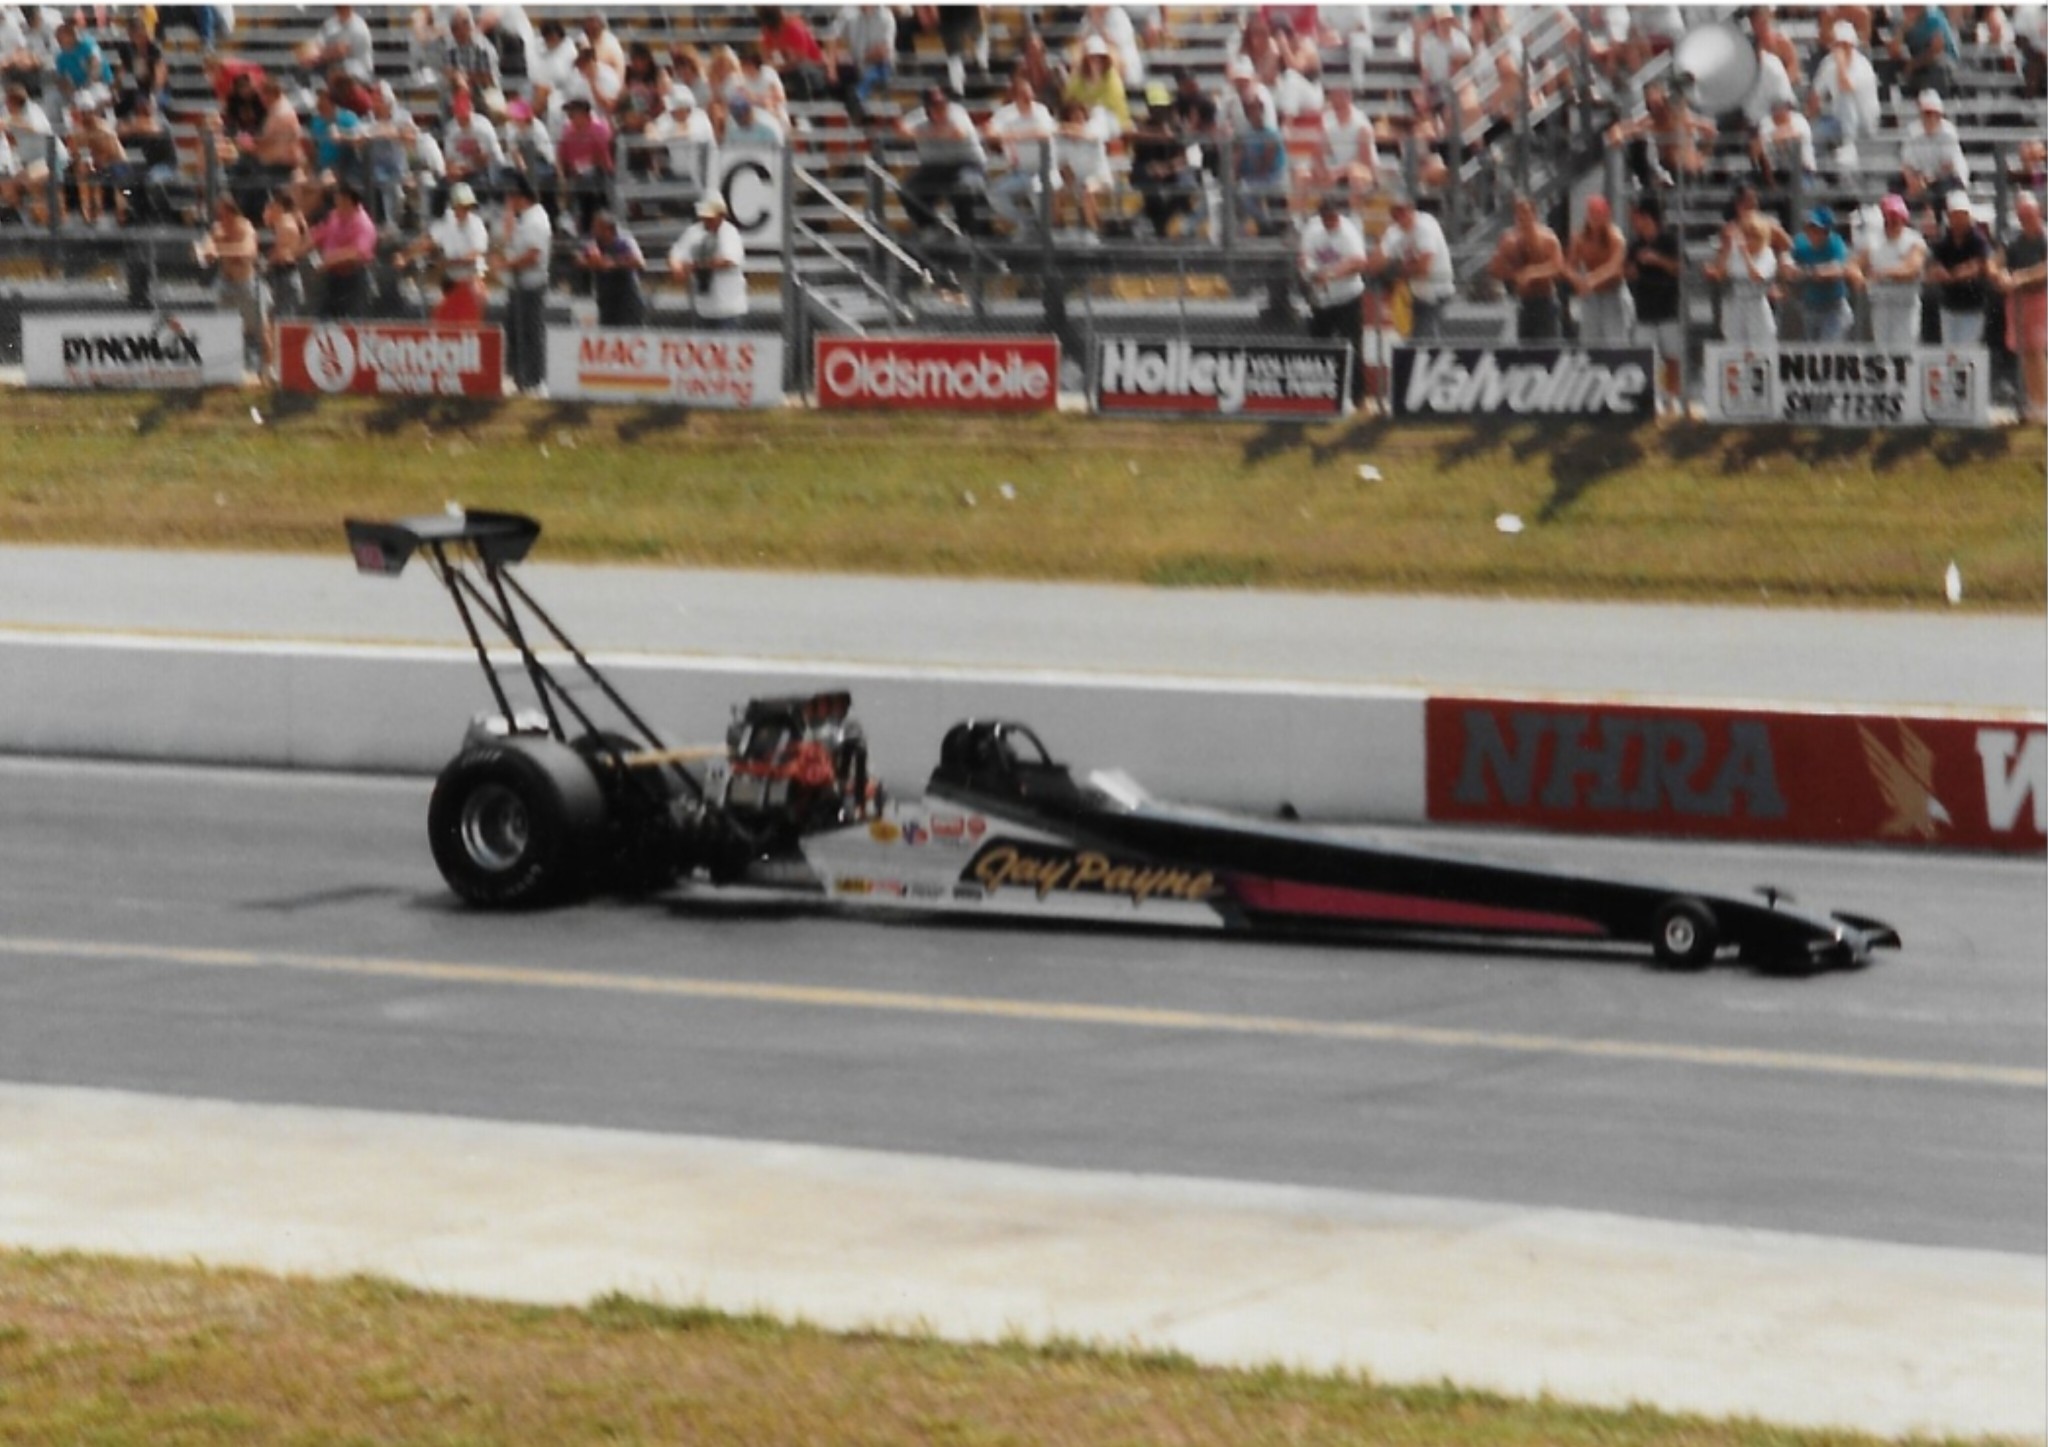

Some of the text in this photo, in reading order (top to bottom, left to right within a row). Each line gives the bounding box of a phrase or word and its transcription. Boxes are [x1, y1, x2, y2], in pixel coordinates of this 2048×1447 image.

[721, 160, 771, 232] C
[360, 326, 481, 374] Kendall
[580, 336, 755, 374] MAC TOOLS
[825, 345, 1050, 399] Oldsmobile
[1102, 338, 1248, 413] Holley
[1401, 347, 1646, 414] Valvoline
[1451, 708, 1787, 820] NHRA
[1068, 852, 1214, 907] Payne
